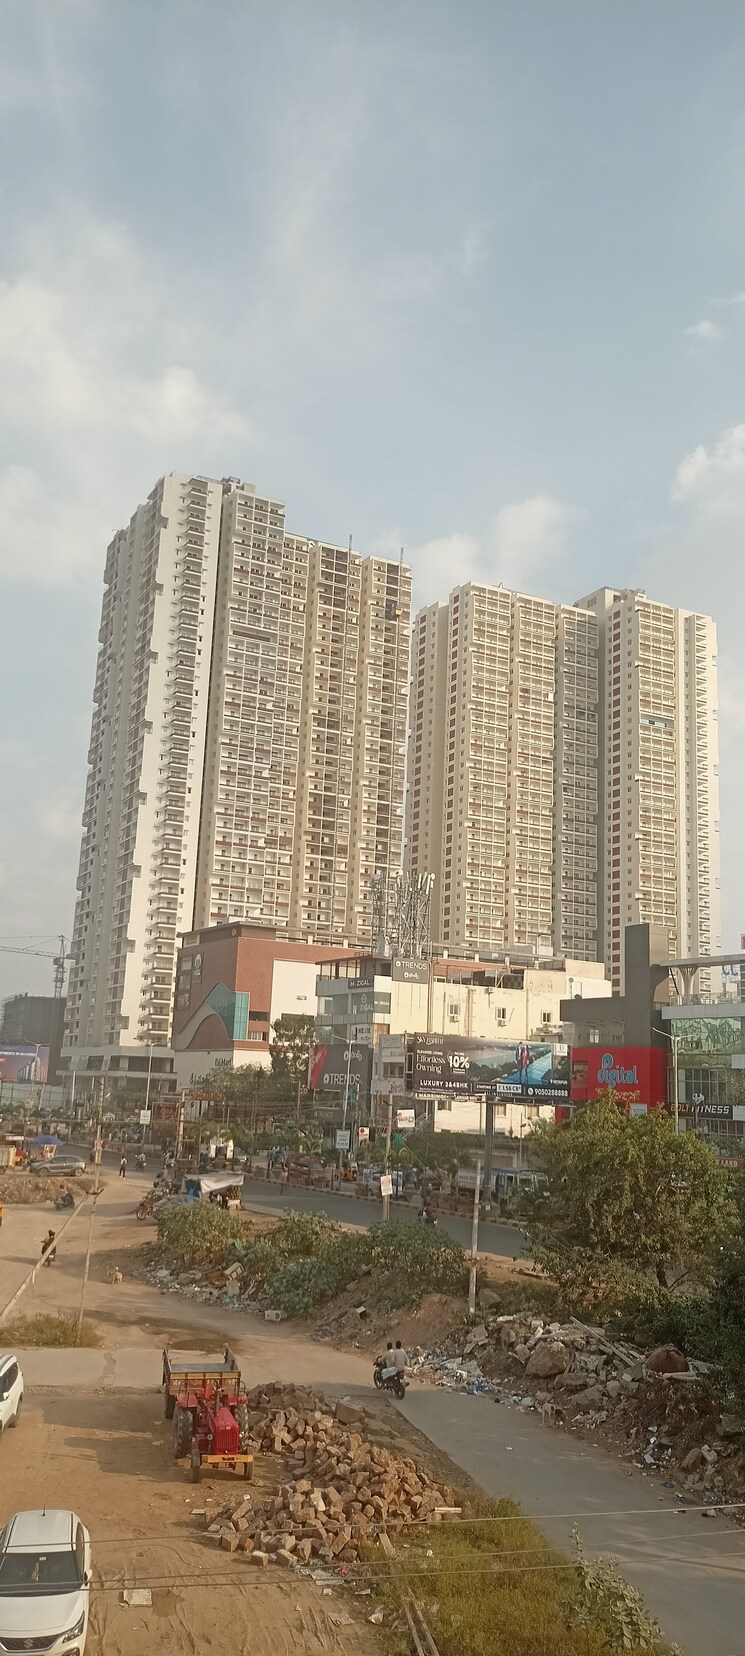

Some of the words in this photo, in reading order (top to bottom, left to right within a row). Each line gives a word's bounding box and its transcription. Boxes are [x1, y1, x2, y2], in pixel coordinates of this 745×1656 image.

[401, 961, 428, 970] TRENDS
[416, 1054, 446, 1064] Effortless
[448, 1055, 470, 1069] 10%
[416, 1063, 442, 1074] Owning
[597, 1053, 639, 1089] digital
[329, 1073, 361, 1086] TRENDS
[534, 1088, 569, 1097] 9050288888
